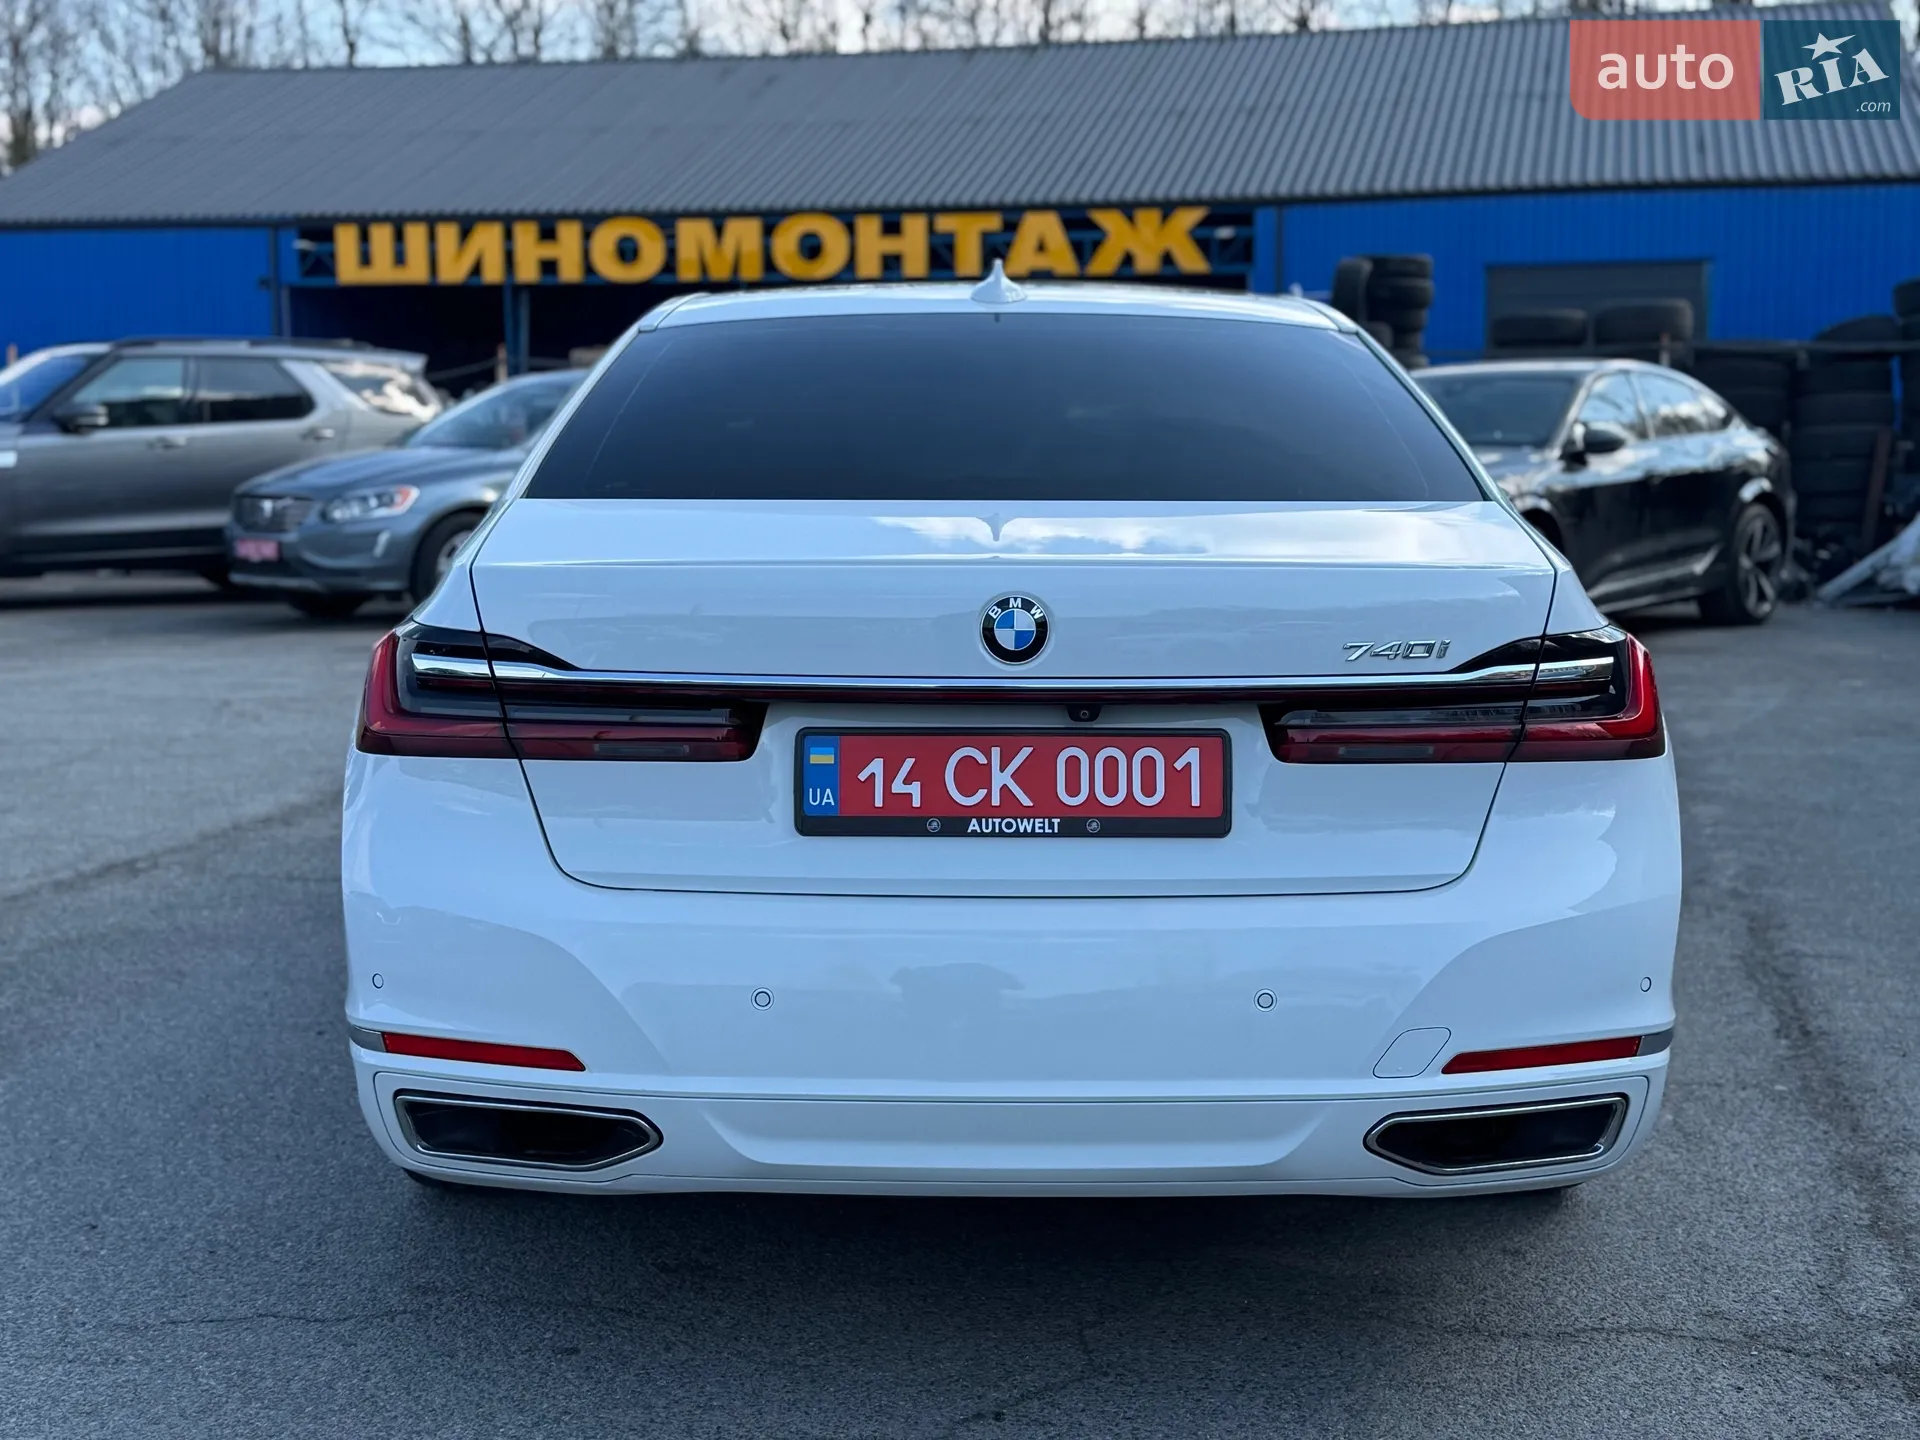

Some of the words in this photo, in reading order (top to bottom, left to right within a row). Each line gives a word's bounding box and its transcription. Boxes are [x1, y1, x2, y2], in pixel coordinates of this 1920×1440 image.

[332, 207, 1212, 287] ШИНОМОНТАЖ
[988, 597, 1044, 620] BMW
[1342, 639, 1451, 662] 740i
[856, 757, 922, 808] 14
[944, 746, 1036, 808] CK
[1056, 746, 1201, 808] 0001
[808, 788, 836, 807] UA
[967, 817, 1061, 835] AUTOWELT
